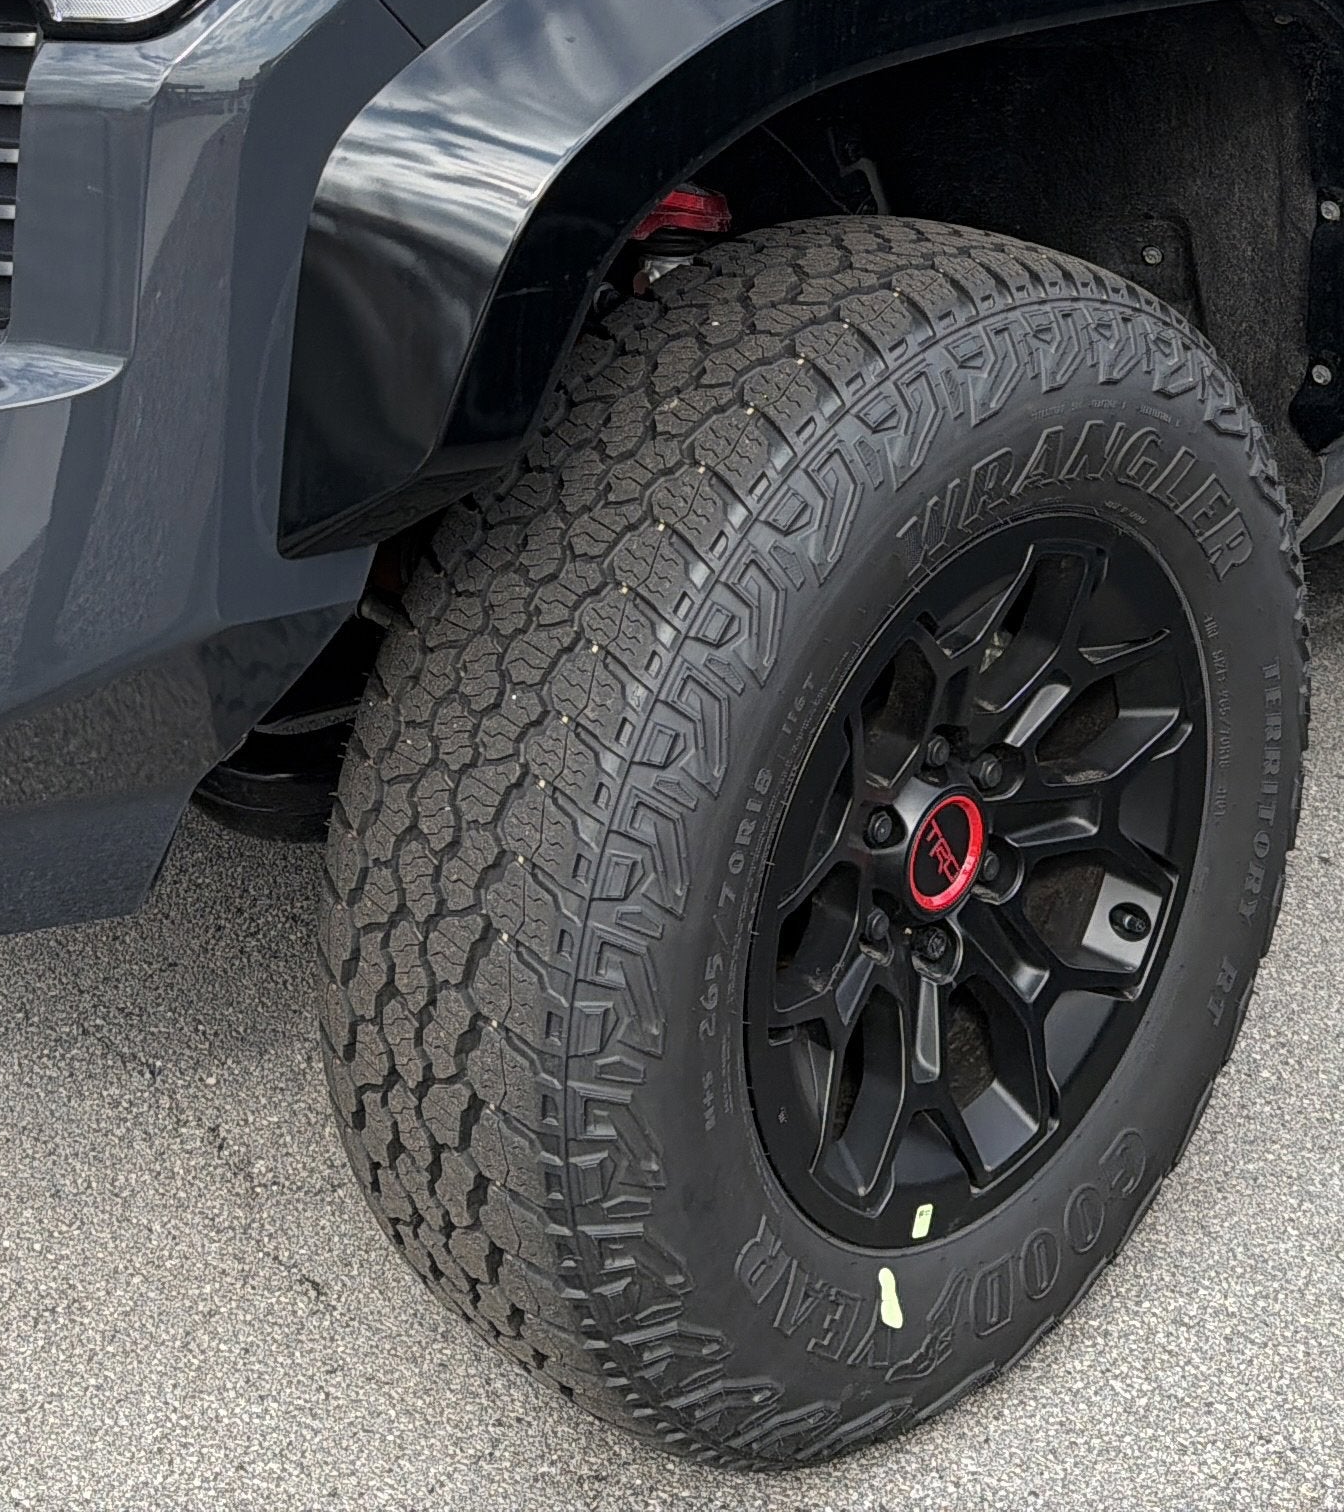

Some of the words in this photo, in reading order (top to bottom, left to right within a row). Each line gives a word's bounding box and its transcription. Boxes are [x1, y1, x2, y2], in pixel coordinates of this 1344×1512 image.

[896, 419, 1255, 583] WRANGLER
[924, 817, 963, 884] TRD
[1237, 656, 1284, 926] TERRITORY
[698, 767, 773, 1040] 265/70R18
[1207, 955, 1238, 1028] RT
